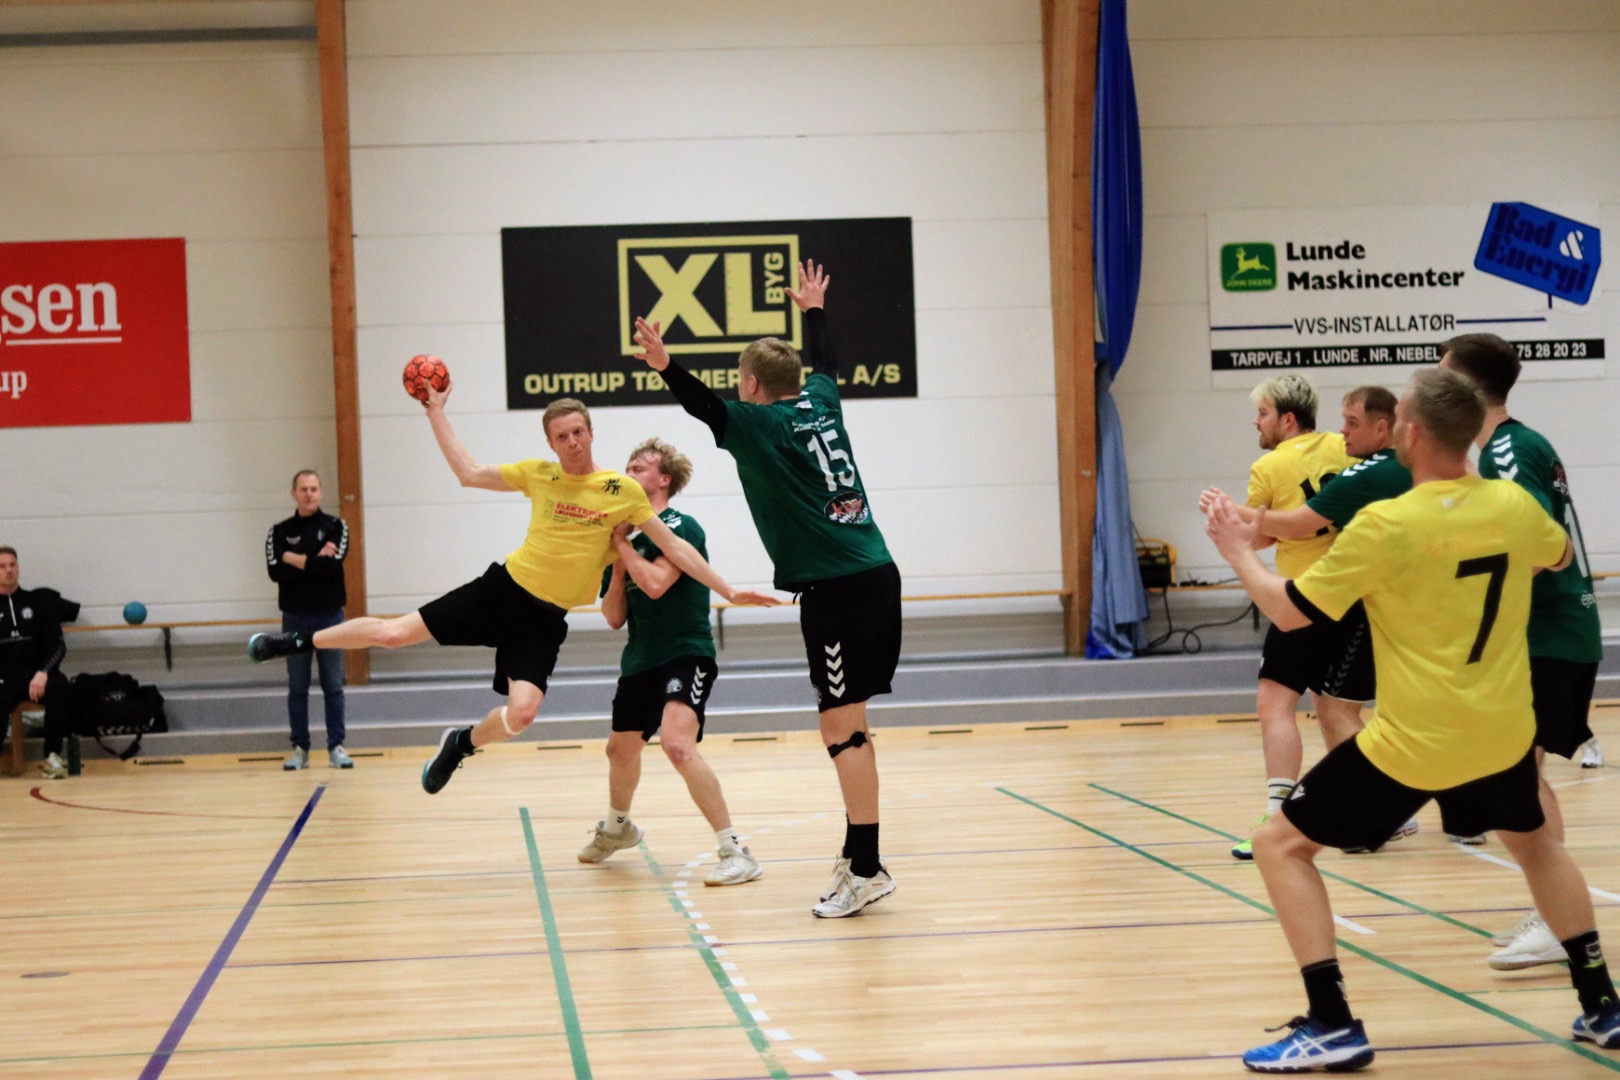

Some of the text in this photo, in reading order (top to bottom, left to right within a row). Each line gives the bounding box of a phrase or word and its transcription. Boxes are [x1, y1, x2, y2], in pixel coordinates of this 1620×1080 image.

[1494, 203, 1557, 249] Bad
[1286, 241, 1366, 261] Lunde
[1485, 232, 1590, 294] Energi
[633, 251, 787, 338] XL BYG
[1287, 267, 1465, 291] Maskincenter
[0, 281, 122, 335] sen
[1293, 313, 1456, 335] VVS-INSTALLATØR
[1231, 351, 1291, 367] TARPVEJ
[1313, 348, 1360, 365] LUNDE
[1369, 347, 1393, 363] NR.
[1396, 345, 1441, 362] NEBEL
[1516, 341, 1587, 358] 75 28 20 23
[524, 372, 625, 395] OUTRUP
[852, 363, 901, 387] A/S
[806, 428, 856, 492] 15
[1454, 551, 1509, 666] 7
